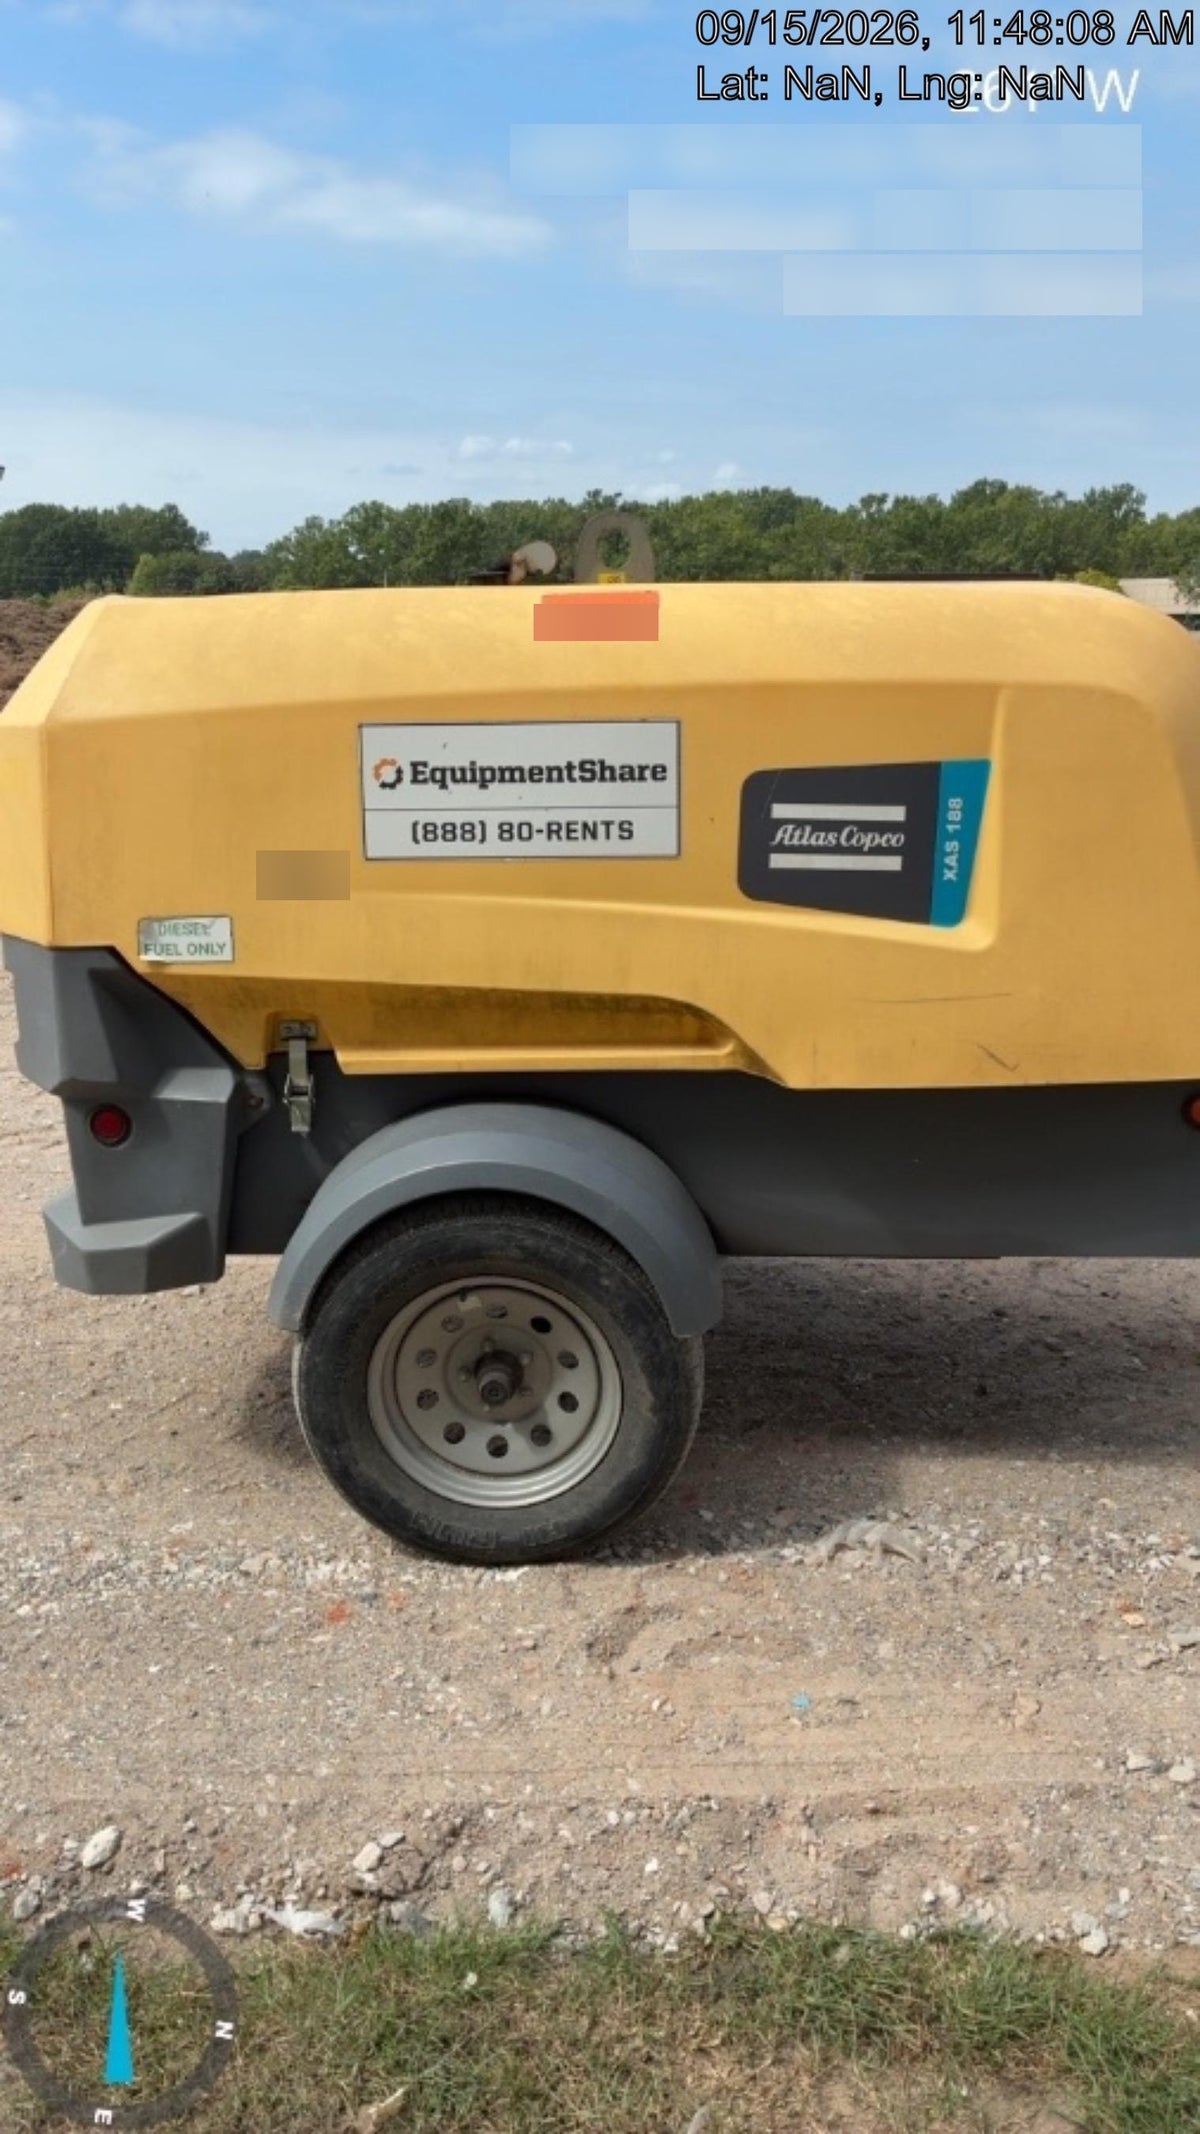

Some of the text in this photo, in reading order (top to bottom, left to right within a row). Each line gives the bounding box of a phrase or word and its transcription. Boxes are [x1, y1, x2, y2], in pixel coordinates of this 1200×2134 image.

[409, 759, 667, 790] EquipmentShare
[411, 820, 635, 844] (888) 80-RENTS
[771, 824, 905, 852] Atlas Copco
[943, 797, 963, 882] XAS 188
[143, 942, 227, 956] FUEL ONLY
